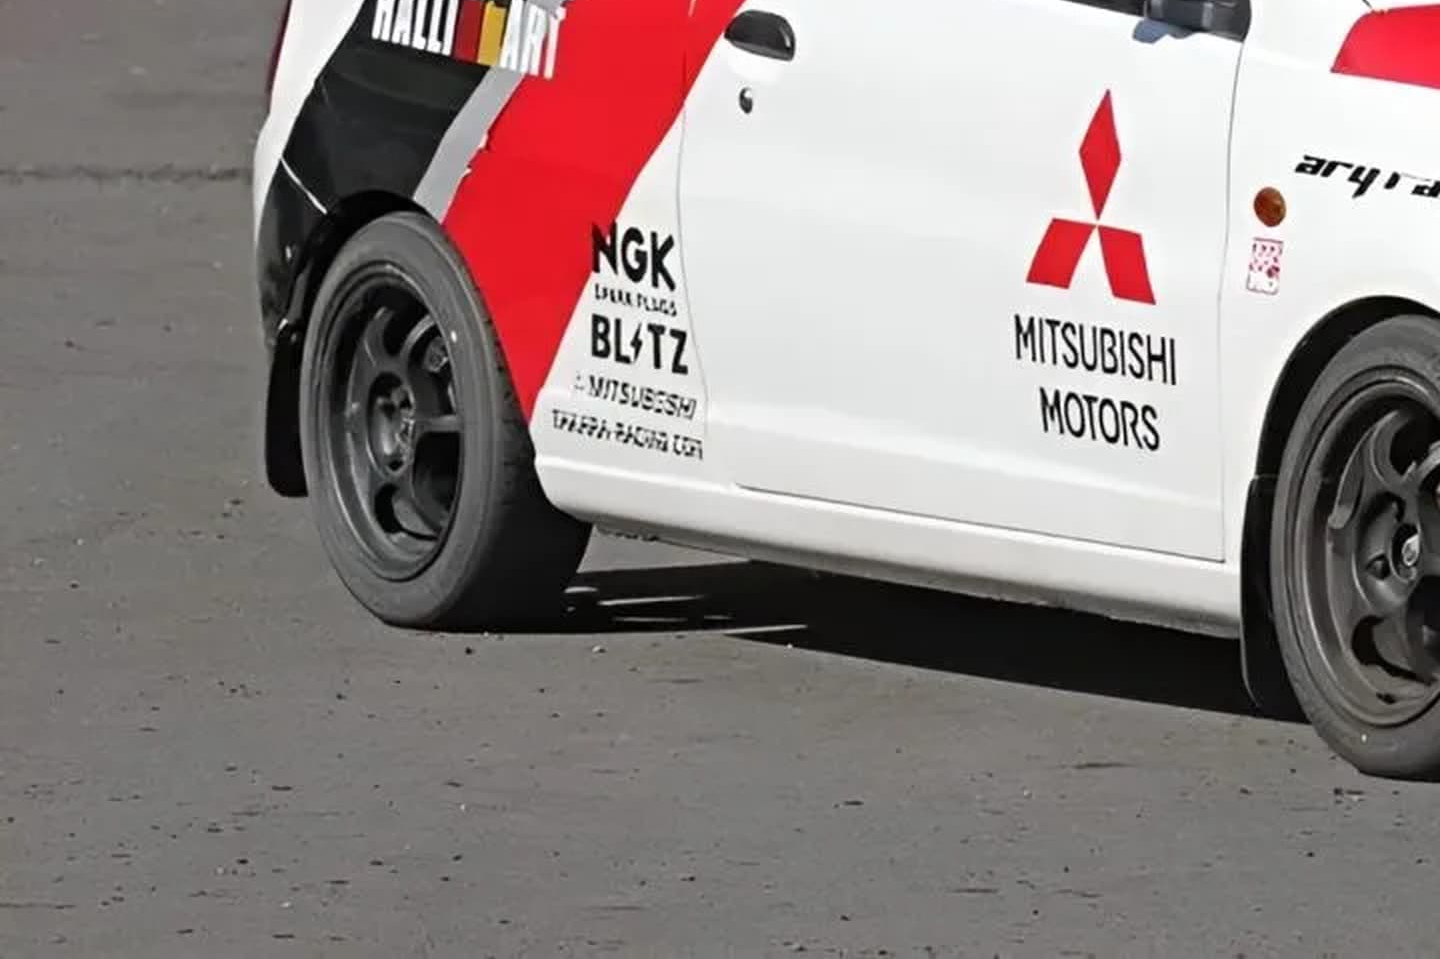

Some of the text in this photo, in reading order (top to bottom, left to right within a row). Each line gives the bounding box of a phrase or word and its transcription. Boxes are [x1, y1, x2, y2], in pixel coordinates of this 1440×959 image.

[591, 218, 677, 293] NGK
[1014, 313, 1177, 386] MITSUBISHI
[1039, 386, 1161, 451] MOTORS
